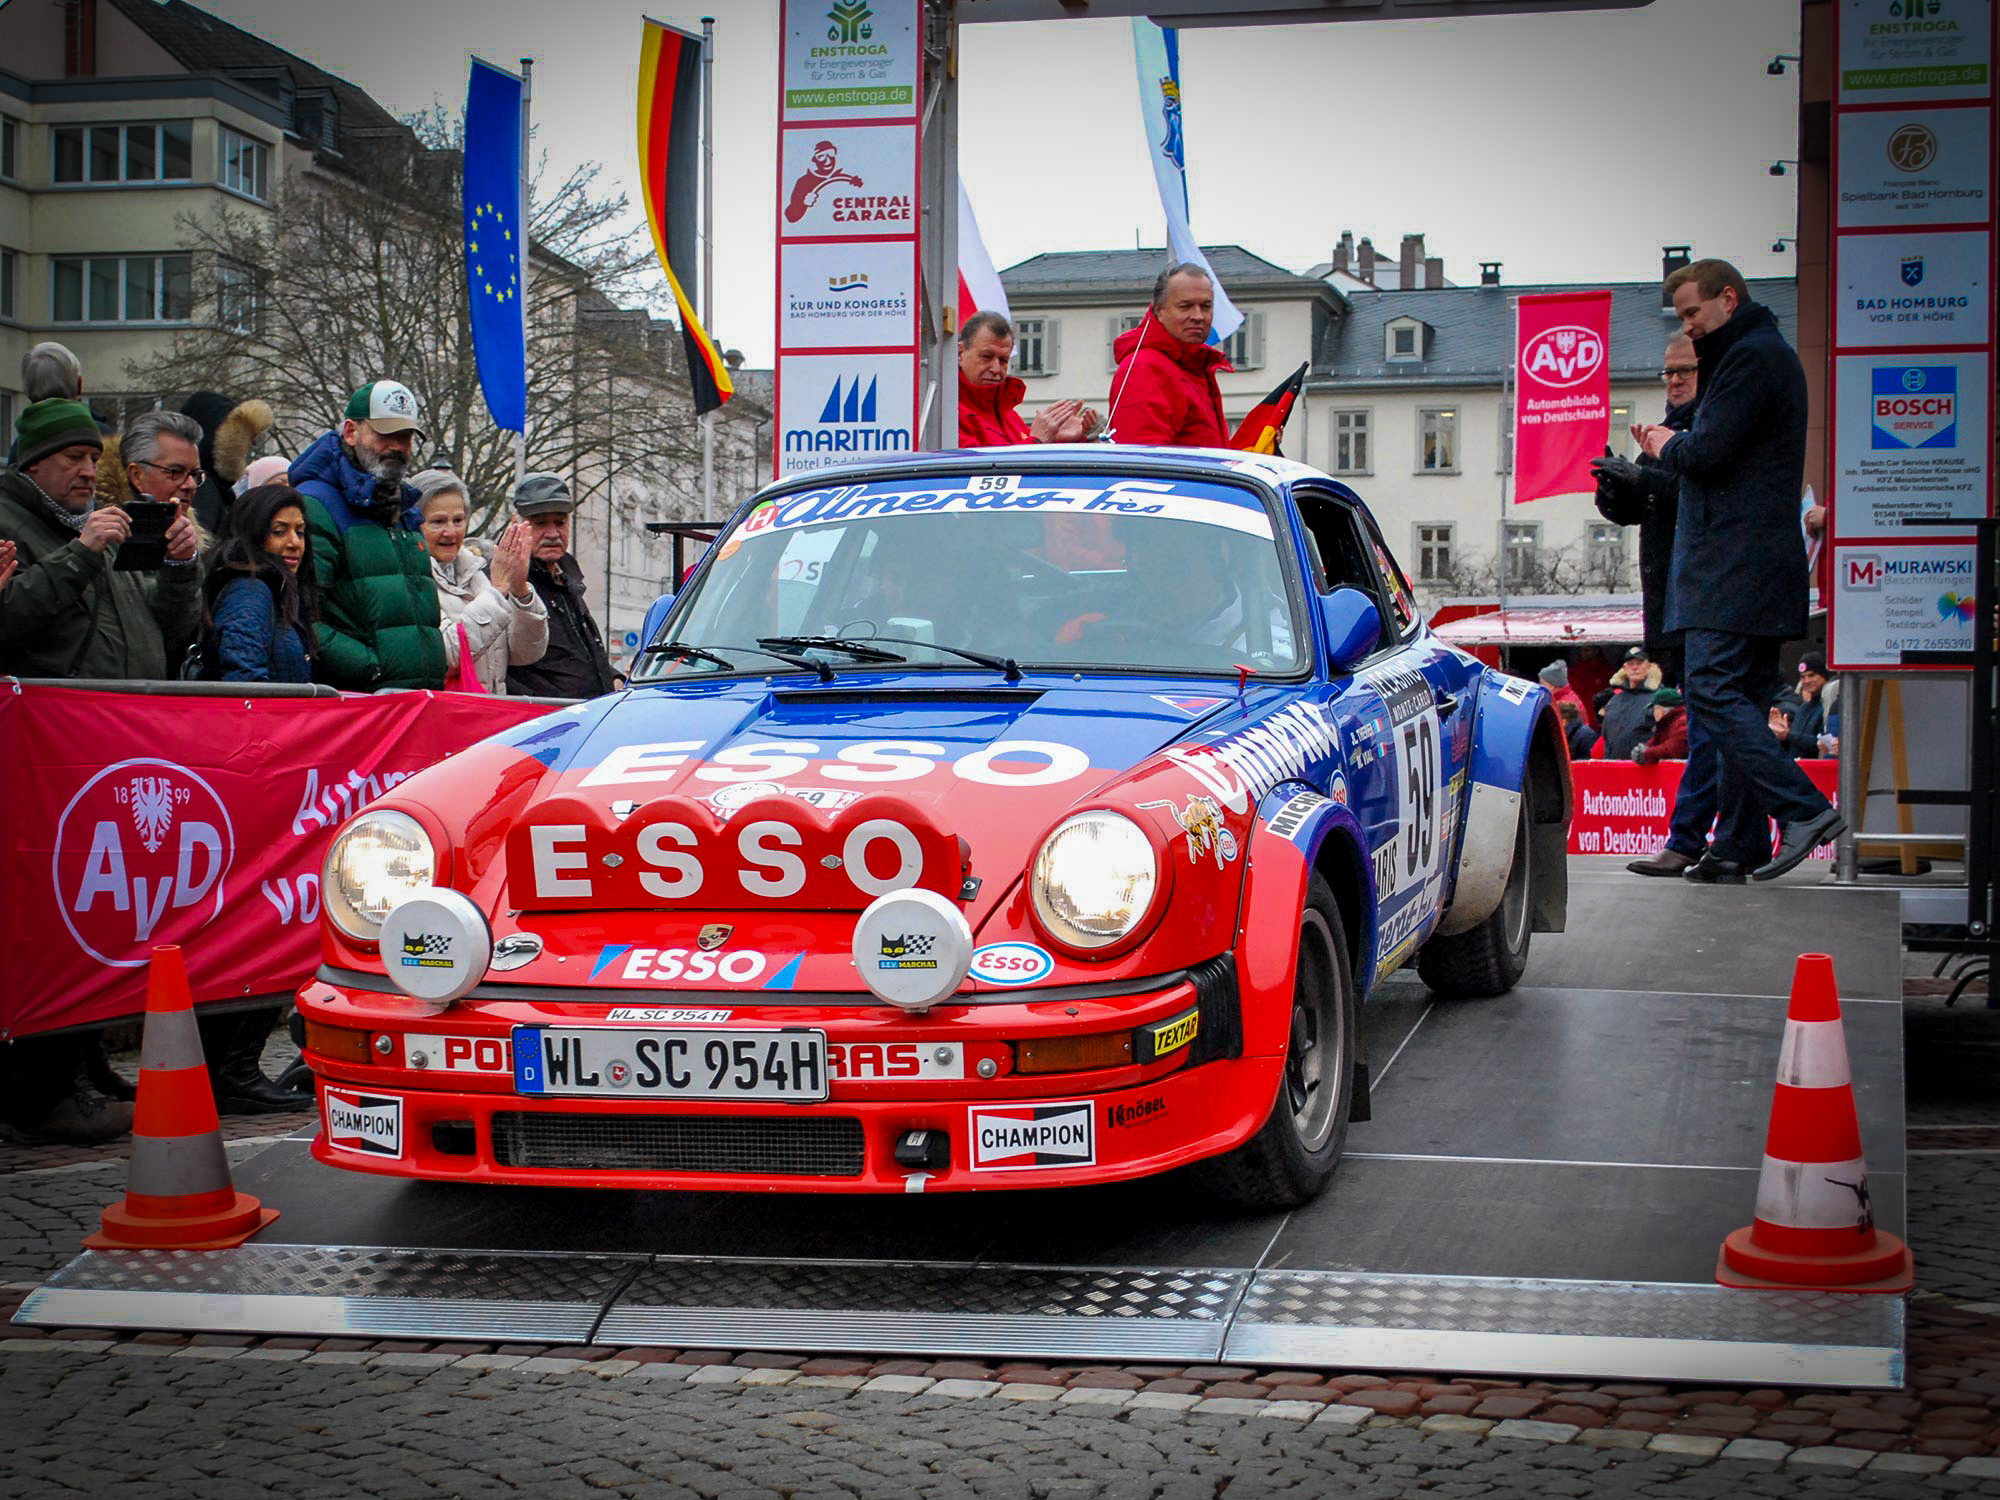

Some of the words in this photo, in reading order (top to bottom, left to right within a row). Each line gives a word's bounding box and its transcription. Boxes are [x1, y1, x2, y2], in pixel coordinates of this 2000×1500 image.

[1870, 20, 1958, 35] ENSTROGA
[810, 45, 887, 57] ENSTROGA
[1888, 48, 1921, 60] Strom
[1925, 47, 1933, 57] &
[827, 70, 856, 80] Strom
[858, 69, 865, 79] &
[869, 68, 887, 79] Gas
[1850, 67, 1981, 86] www.enstroga.de
[792, 88, 907, 104] www.enstroga.de
[833, 196, 910, 208] CENTRAL
[1841, 191, 1898, 203] Spielbank
[1902, 189, 1926, 200] Bad
[1928, 188, 1983, 200] Homburg
[832, 208, 910, 222] GARAGE
[791, 301, 813, 310] KUR
[817, 300, 841, 310] UND
[844, 299, 907, 309] KONGRESS
[1857, 298, 1887, 310] BAD
[1891, 296, 1968, 309] HOMBURG
[1870, 313, 1893, 322] VOR
[1897, 313, 1918, 322] DER
[1924, 311, 1955, 322] HÖHE
[1527, 396, 1600, 411] Automobilclub
[1876, 399, 1951, 416] BOSCH
[1521, 414, 1541, 425] von
[1543, 406, 1605, 423] Deutschland
[1893, 421, 1935, 430] SERVICE
[786, 429, 910, 452] MARITIM
[786, 457, 820, 470] Hotel
[1860, 459, 1884, 467] Bosch
[1886, 459, 1899, 467] Car
[1902, 458, 1930, 467] Service
[1932, 458, 1966, 466] KRAUSE
[980, 477, 1008, 490] 59
[1877, 476, 1892, 484] KFZ
[1894, 475, 1949, 484] Meisterbetrieb
[1853, 485, 1898, 493] Fachbetrieb
[1925, 501, 1942, 511] Weg
[750, 509, 772, 531] H
[1899, 510, 1914, 518] Bad
[1915, 510, 1951, 519] Homburg
[1851, 562, 1874, 584] M
[1884, 560, 1972, 574] MURAWSKI
[1884, 575, 1972, 586] Beschriftungen
[1885, 596, 1923, 605] Schilder
[1885, 608, 1924, 619] Stempel
[1885, 620, 1936, 629] Textildruck
[1885, 639, 1920, 650] 06172
[1923, 638, 1972, 649] 2655390
[577, 740, 1090, 788] ESSO
[113, 786, 128, 804] 18
[174, 788, 190, 805] 99
[1402, 714, 1435, 877] 59
[1583, 788, 1666, 818] Automobilclub
[1578, 831, 1600, 853] von
[1603, 826, 1671, 853] Deutschlan
[622, 948, 766, 982] ESSO
[899, 960, 936, 969] MARCHAL
[611, 1010, 635, 1020] WL
[639, 1010, 666, 1020] SC
[672, 1010, 707, 1020] 954
[1157, 1015, 1197, 1048] TEXTAR
[544, 1037, 600, 1086] WL
[635, 1038, 691, 1088] SC
[524, 1067, 533, 1081] D
[331, 1108, 394, 1137] CHAMPION
[981, 1124, 1085, 1149] CHAMPION
